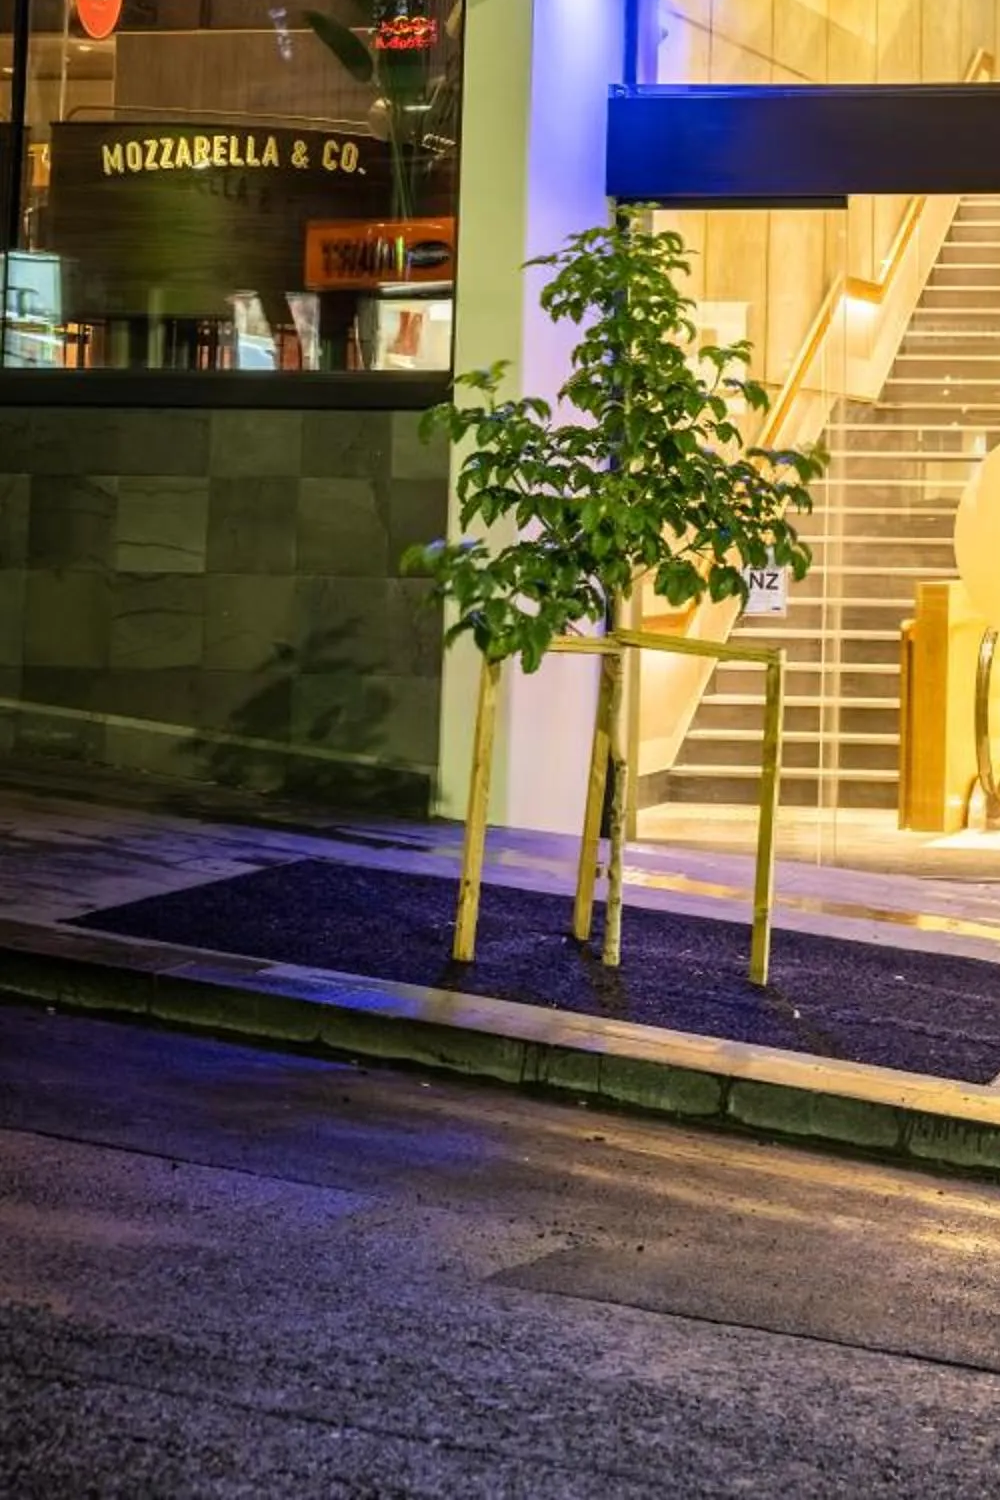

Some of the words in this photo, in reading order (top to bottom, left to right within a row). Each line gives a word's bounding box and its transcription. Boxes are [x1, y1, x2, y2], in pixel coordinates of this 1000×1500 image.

[102, 135, 280, 176] MOZZARELLA
[291, 140, 309, 169] &
[322, 139, 366, 175] CO.
[749, 571, 779, 590] NZ
